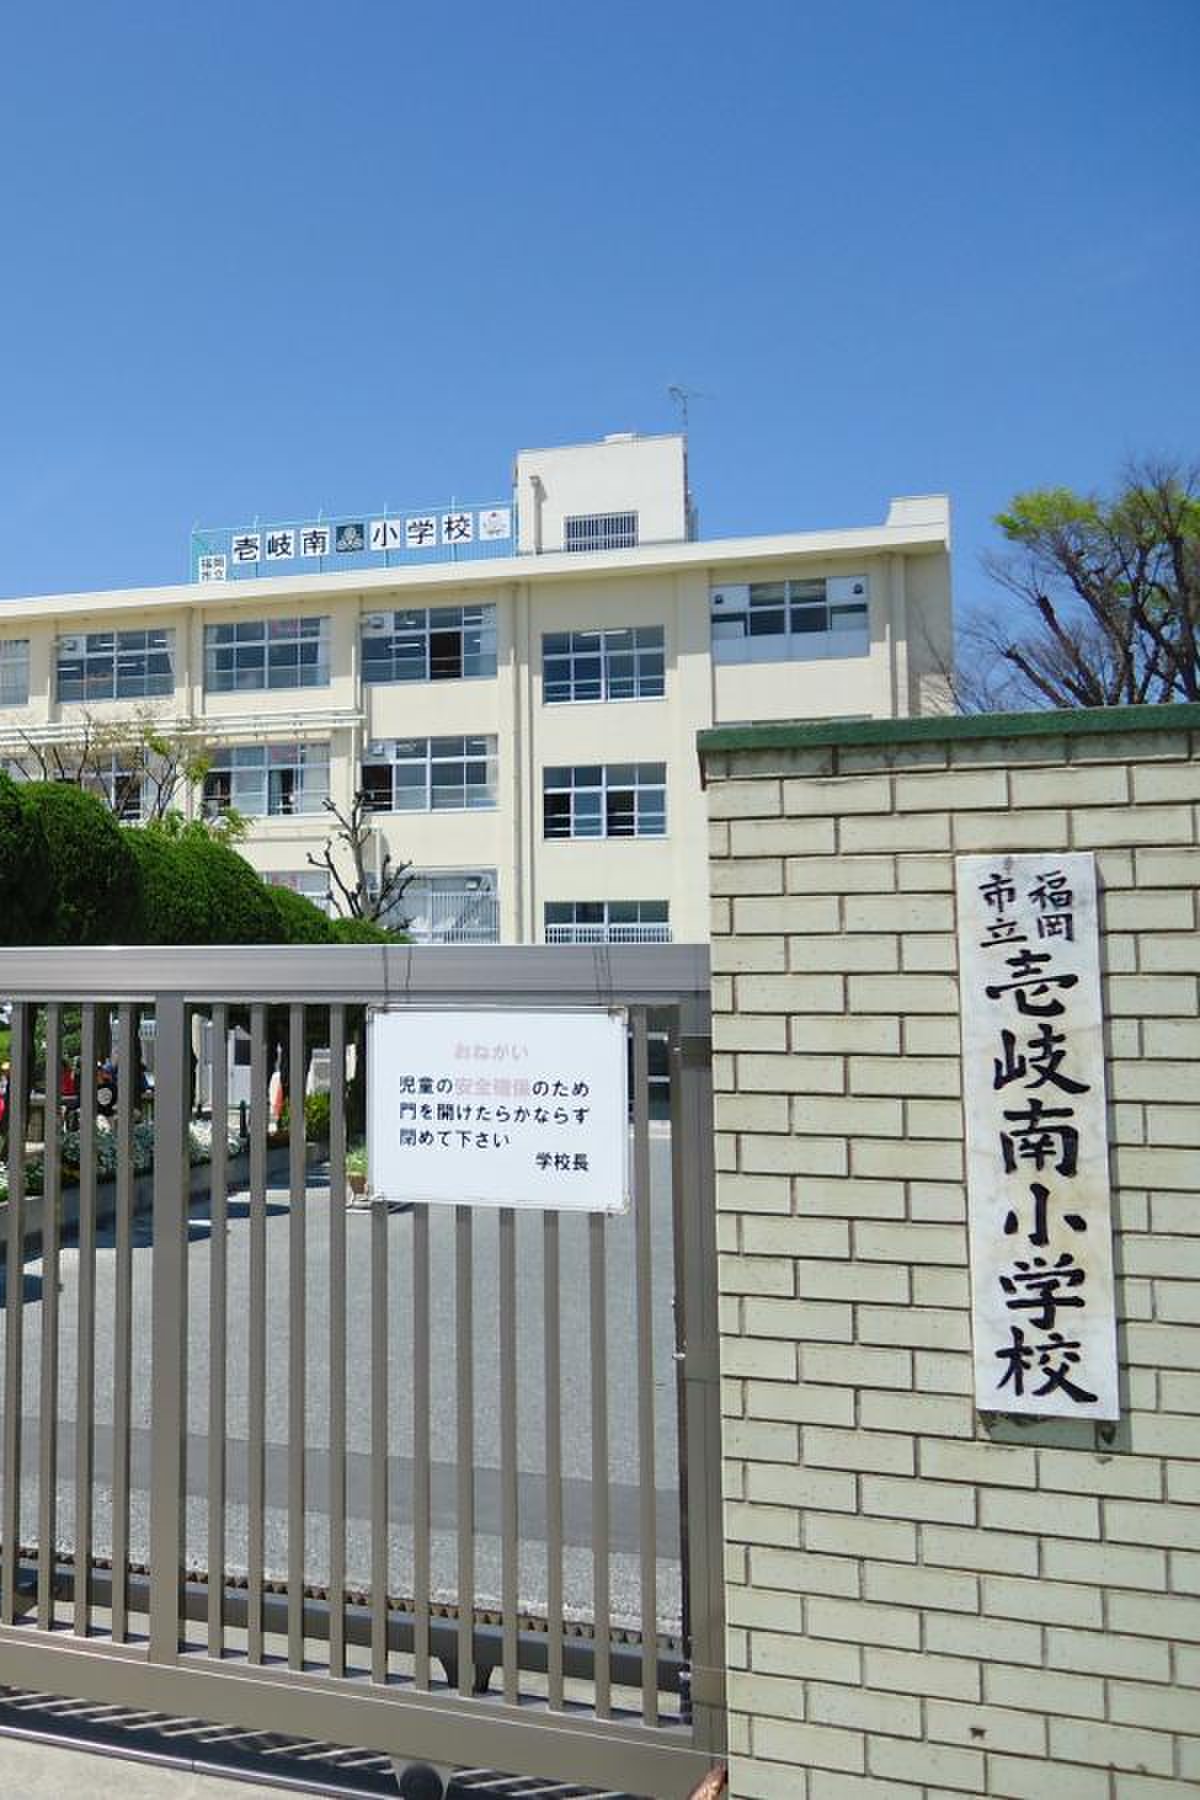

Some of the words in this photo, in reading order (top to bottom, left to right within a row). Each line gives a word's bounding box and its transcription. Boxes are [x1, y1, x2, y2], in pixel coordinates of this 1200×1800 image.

[373, 515, 470, 546] 小学校
[978, 873, 1028, 948] 市立
[1027, 869, 1074, 943] 福岡
[454, 1043, 529, 1061] おねがい
[399, 1128, 510, 1149] 閉めて下さい
[535, 1151, 589, 1172] 学校長
[985, 948, 1099, 1403] 壱岐南小学校
